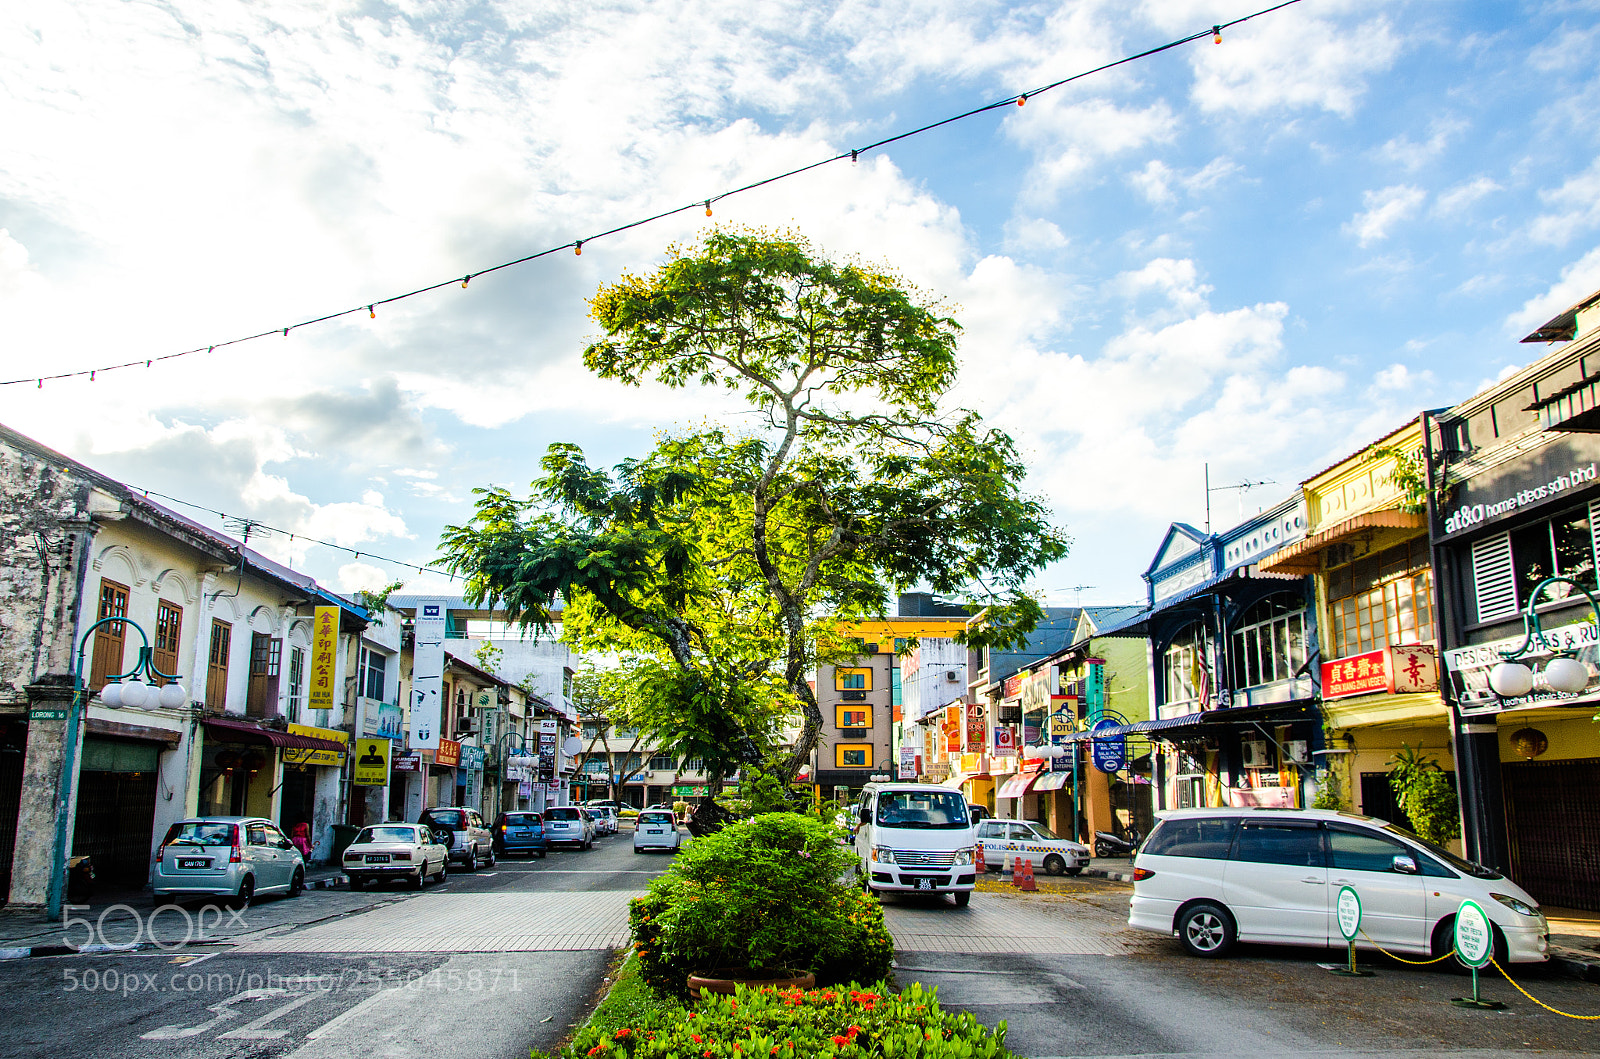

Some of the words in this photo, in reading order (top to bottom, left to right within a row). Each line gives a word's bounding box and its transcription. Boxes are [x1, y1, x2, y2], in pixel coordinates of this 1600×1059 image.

[1485, 497, 1517, 518] home
[1517, 485, 1548, 506] ideas
[1548, 475, 1571, 495] sdn
[1570, 462, 1597, 487] bhd
[1564, 631, 1576, 649] &
[1402, 653, 1426, 687] 素
[1330, 683, 1343, 694] ZHEN
[1342, 681, 1357, 692] XIANG
[1356, 679, 1368, 690] ZHAI
[1368, 675, 1387, 688] VEGETA
[1534, 692, 1557, 702] Fabric
[968, 705, 985, 718] 4D
[1052, 724, 1078, 732] JOTUN
